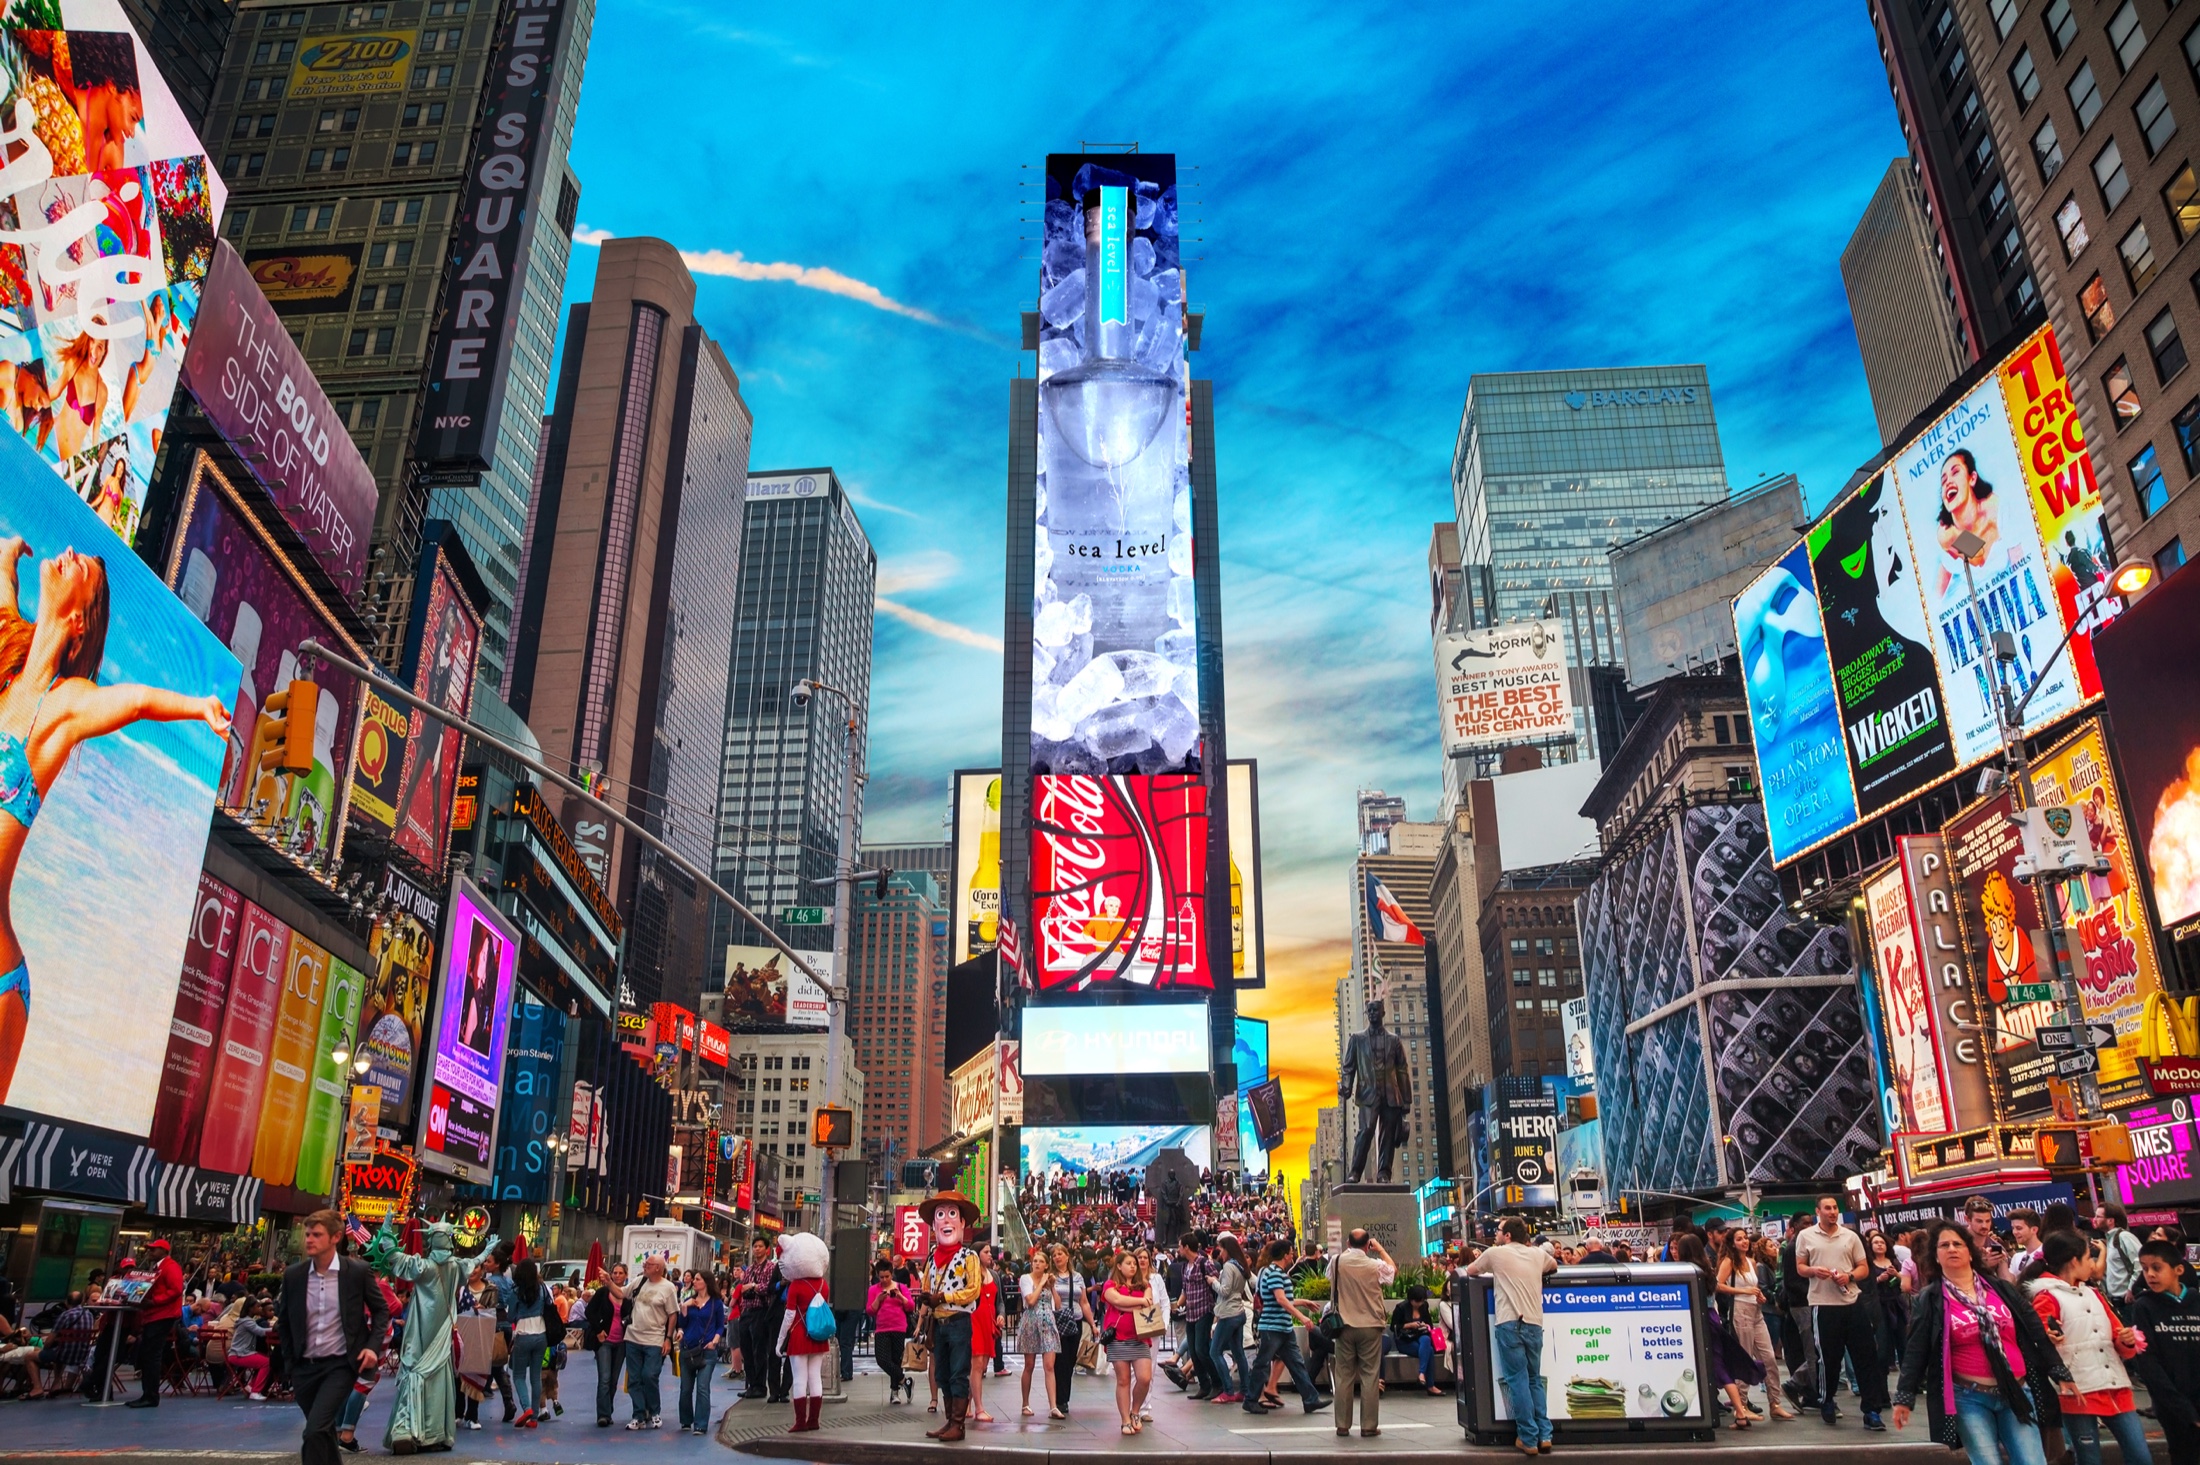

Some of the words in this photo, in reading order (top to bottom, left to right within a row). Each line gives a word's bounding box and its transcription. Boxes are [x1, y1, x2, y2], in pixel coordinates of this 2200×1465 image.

[309, 39, 403, 70] Z100
[292, 86, 315, 96] Hit
[314, 84, 354, 94] Music
[356, 81, 402, 91] Station
[304, 76, 336, 85] New
[338, 71, 374, 83] York's
[1107, 206, 1117, 230] sea
[444, 112, 527, 380] SQUARE
[1106, 236, 1121, 274] level
[238, 303, 279, 392] THE
[275, 372, 330, 467] BOLD
[1592, 387, 1697, 408] BARCLAYS
[434, 415, 471, 429] NYC
[1919, 425, 1943, 452] THE
[1945, 401, 1970, 431] FUN
[1908, 443, 1945, 482] NEVER
[1947, 403, 1991, 451] STOPS!
[221, 356, 273, 447] SIDE
[273, 428, 302, 477] OF
[300, 461, 353, 565] WATER
[1068, 543, 1101, 558] sea
[1115, 533, 1165, 559] level
[1102, 564, 1141, 573] VODKA
[1938, 608, 1954, 622] BENNY
[1941, 567, 2048, 675] MAMMA
[1451, 671, 1486, 683] WINNER
[1489, 670, 1495, 678] 9
[1496, 667, 1520, 677] TONY
[1521, 662, 1559, 674] AWARDS
[1452, 680, 1488, 695] BEST
[1493, 671, 1561, 688] MUSICAL
[1842, 660, 1877, 692] BIGGEST
[1503, 683, 1561, 706] BEST
[1454, 704, 1535, 726] MUSICAL
[1537, 700, 1563, 715] OF
[1799, 703, 1821, 724] Musical
[1456, 722, 1490, 738] THIS
[1976, 718, 1994, 735] SMASH
[358, 717, 388, 788] Q
[1788, 738, 1808, 757] The
[1768, 736, 1840, 795] PHANTOM
[2071, 748, 2091, 774] Jessie
[1793, 779, 1803, 799] of
[1803, 774, 1819, 794] the
[2069, 761, 2103, 795] MUELLER
[1784, 787, 1832, 827] OPERA
[1974, 810, 2003, 833] ULTIMATE
[1956, 833, 1988, 860] FEEL-GOOD
[1975, 844, 1991, 859] BACK
[1991, 834, 2005, 848] AND
[2052, 839, 2076, 848] SECURITY
[1962, 862, 1982, 879] BETTER
[1981, 853, 1999, 870] THAN
[200, 874, 238, 904] SPARKLING
[393, 879, 415, 910] JOY
[413, 890, 439, 926] RIDE!
[1876, 887, 1899, 918] CAUSE
[189, 888, 236, 959] ICE
[252, 907, 286, 933] SPARKLING
[785, 909, 794, 923] W
[796, 909, 809, 923] 46
[811, 908, 820, 917] ST
[2075, 904, 2122, 953] NICE
[242, 920, 283, 985] ICE
[806, 954, 818, 968] By
[1921, 852, 1977, 1065] PALACE
[2076, 938, 2138, 993] WORK
[195, 970, 226, 991] Raspberry
[287, 948, 323, 1006] ICE
[328, 972, 358, 1027] ICE
[797, 984, 814, 996] did
[814, 985, 824, 997] it.
[2009, 988, 2019, 1001] W
[2022, 986, 2036, 1000] 46
[2038, 985, 2047, 993] ST
[2085, 995, 2092, 1010] If
[2092, 994, 2105, 1008] You
[2105, 990, 2117, 1006] Can
[2116, 984, 2128, 999] Get
[2128, 981, 2136, 994] It
[794, 1001, 825, 1010] LEADERSHIP
[2100, 1002, 2145, 1025] Tony-Winning
[186, 1027, 211, 1044] CALORIES
[1996, 1000, 2055, 1053] Annie
[706, 1034, 727, 1054] PLAZA
[1084, 1030, 1198, 1050] HYUNDAI
[2045, 1032, 2067, 1044] ONE
[240, 1047, 262, 1064] CALORIES
[367, 1035, 410, 1066] MOTOWN
[529, 1048, 554, 1062] Stanley
[2008, 1055, 2055, 1076] TICKETMASTER.COM
[2062, 1060, 2074, 1072] ONE
[2078, 1055, 2092, 1068] WAY
[369, 1070, 378, 1084] ON
[376, 1072, 402, 1092] BROADWAY
[429, 1104, 447, 1136] CNN
[1510, 1115, 1557, 1138] HERO
[1513, 1146, 1536, 1157] JUNE
[1537, 1145, 1544, 1156] 6
[1973, 1139, 1995, 1158] Annie
[2131, 1126, 2173, 1159] IMES
[90, 1152, 114, 1167] WE'RE
[979, 1145, 987, 1177] OLIVE
[1919, 1152, 1938, 1169] Annie
[1945, 1146, 1966, 1163] Annie
[87, 1166, 108, 1179] OPEN
[351, 1163, 407, 1192] ROXY
[1520, 1168, 1538, 1176] TNT
[2127, 1153, 2193, 1188] SQUARE
[210, 1181, 230, 1195] WE'RE
[207, 1195, 226, 1209] OPEN
[1884, 1211, 1898, 1225] BOX
[1897, 1208, 1919, 1223] OFFICE
[1918, 1206, 1937, 1219] HERE
[1362, 1222, 1398, 1232] GEORGE
[1625, 1228, 1640, 1238] OUT
[1641, 1228, 1655, 1238] OF
[634, 1242, 653, 1250] TOUR
[653, 1242, 668, 1250] FOR
[668, 1243, 681, 1251] LIFE
[1565, 1291, 1607, 1304] Green
[1610, 1291, 1635, 1304] and
[1638, 1290, 1682, 1302] Clean!
[1570, 1325, 1612, 1337] recycle
[1640, 1323, 1683, 1336] recycle
[1585, 1339, 1599, 1349] all
[1642, 1337, 1683, 1347] bottles
[1576, 1354, 1610, 1364] paper
[1644, 1350, 1653, 1360] &
[1656, 1351, 1684, 1360] cans
